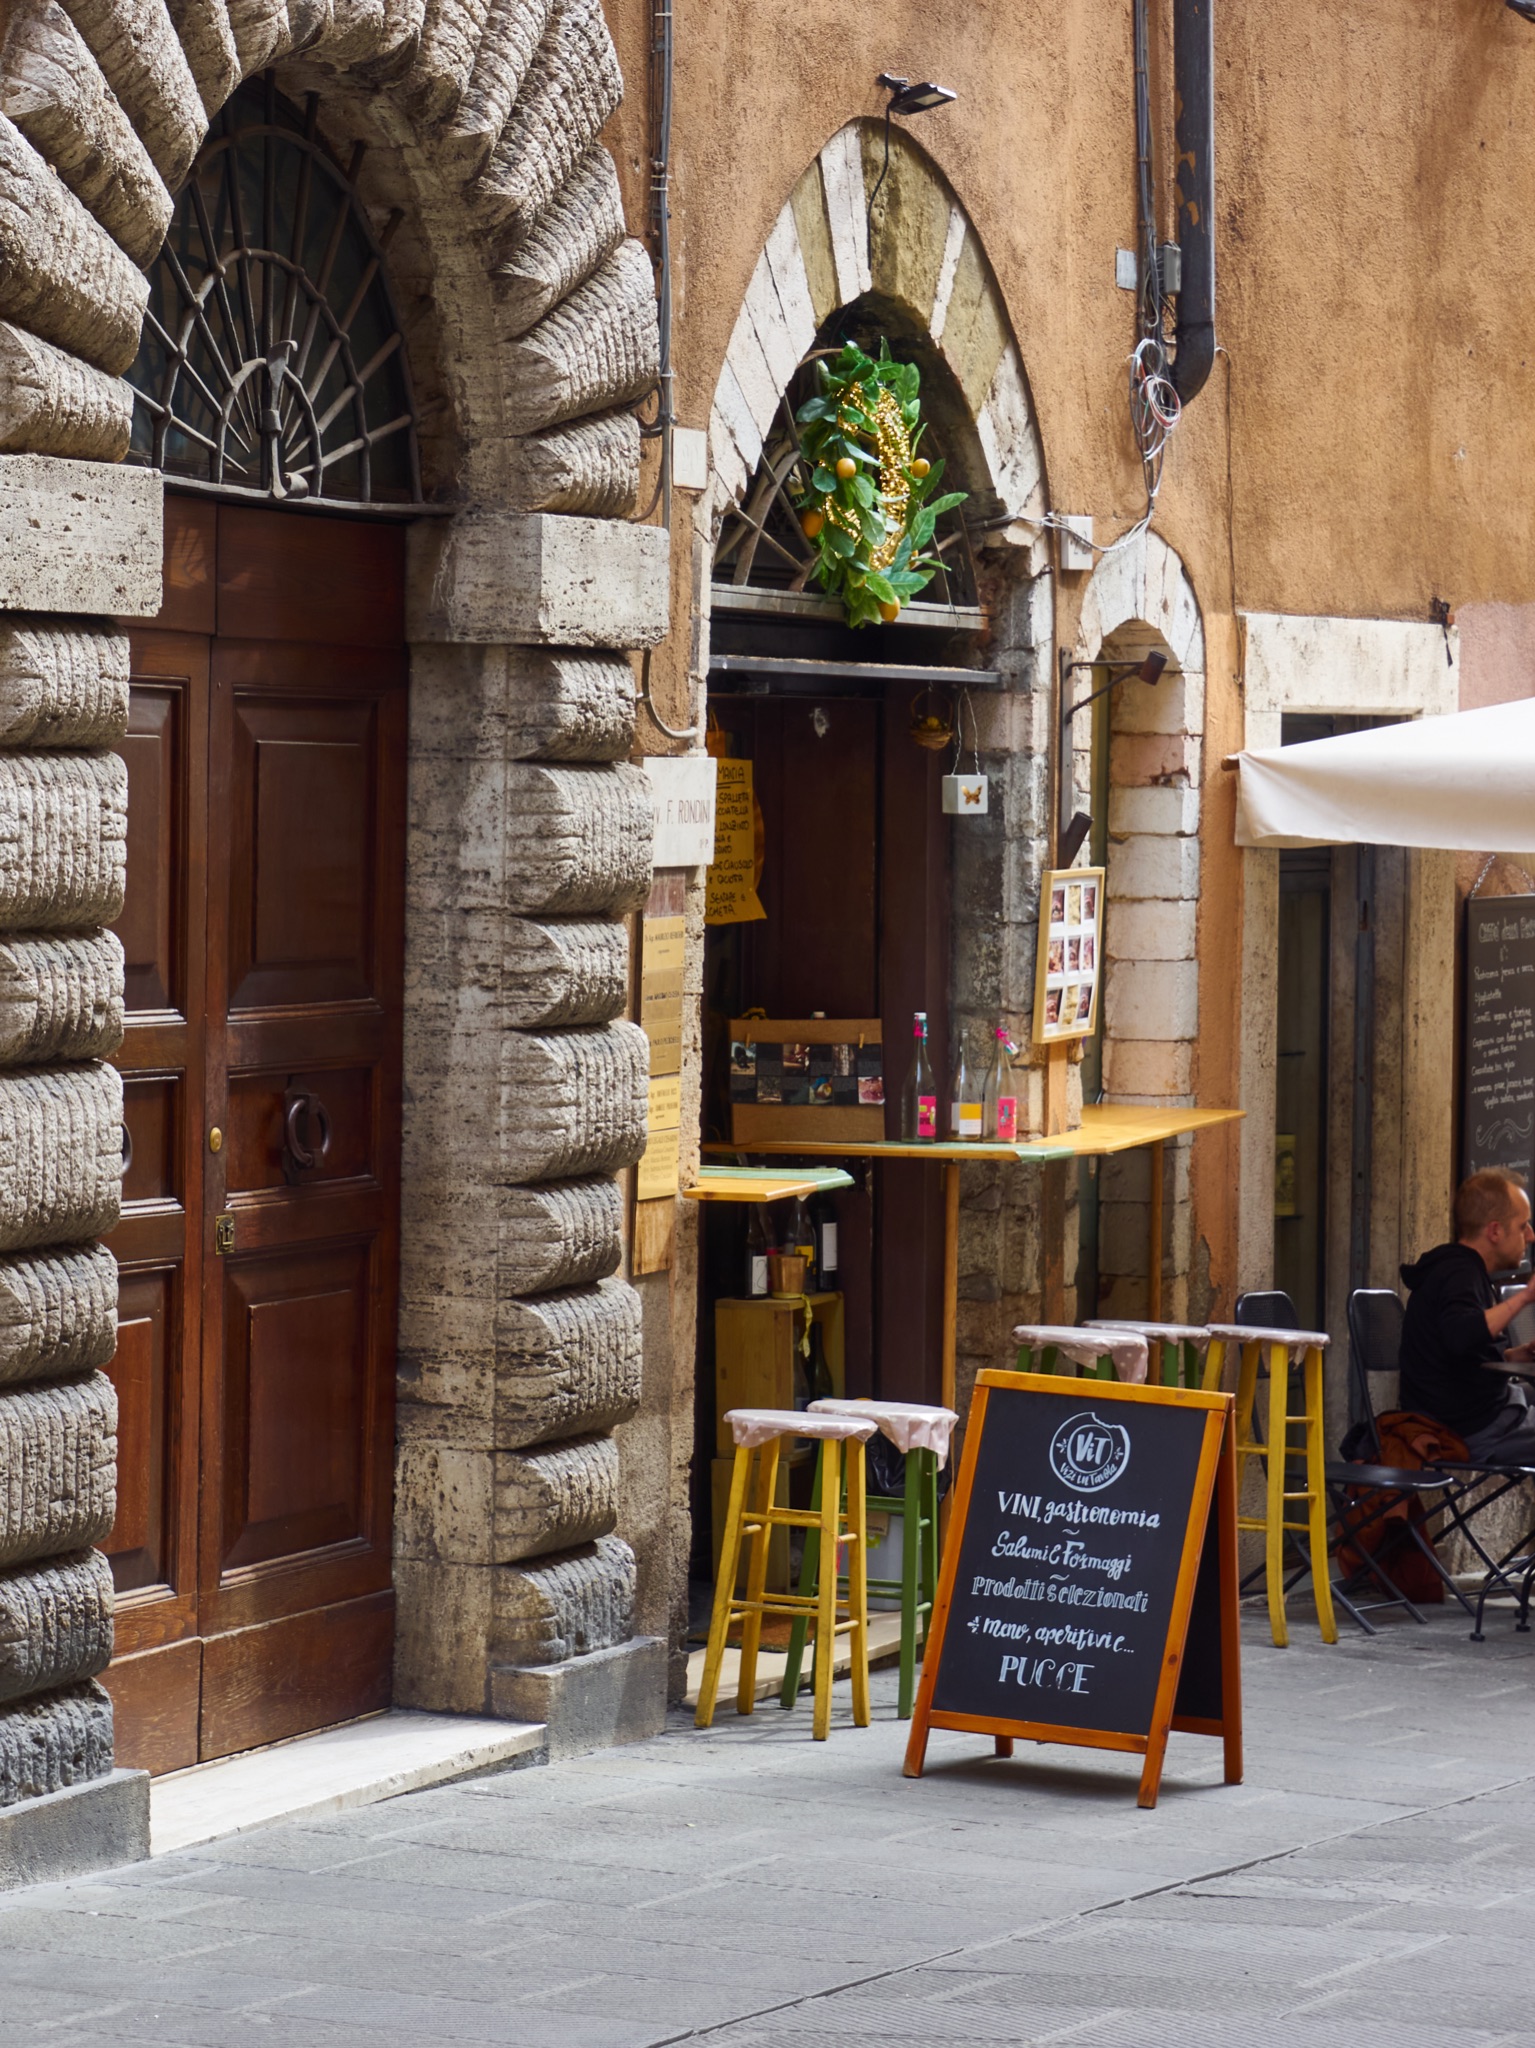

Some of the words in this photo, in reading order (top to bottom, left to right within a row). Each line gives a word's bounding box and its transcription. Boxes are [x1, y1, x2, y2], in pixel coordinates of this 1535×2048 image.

[678, 799, 711, 824] RONDINI
[998, 1490, 1042, 1523] VINI,
[1043, 1500, 1161, 1528] gastronomia
[991, 1531, 1049, 1561] Salumi
[1062, 1540, 1133, 1580] Formaggi
[970, 1575, 1045, 1601] Prodotti
[998, 1654, 1095, 1694] PUCCE
